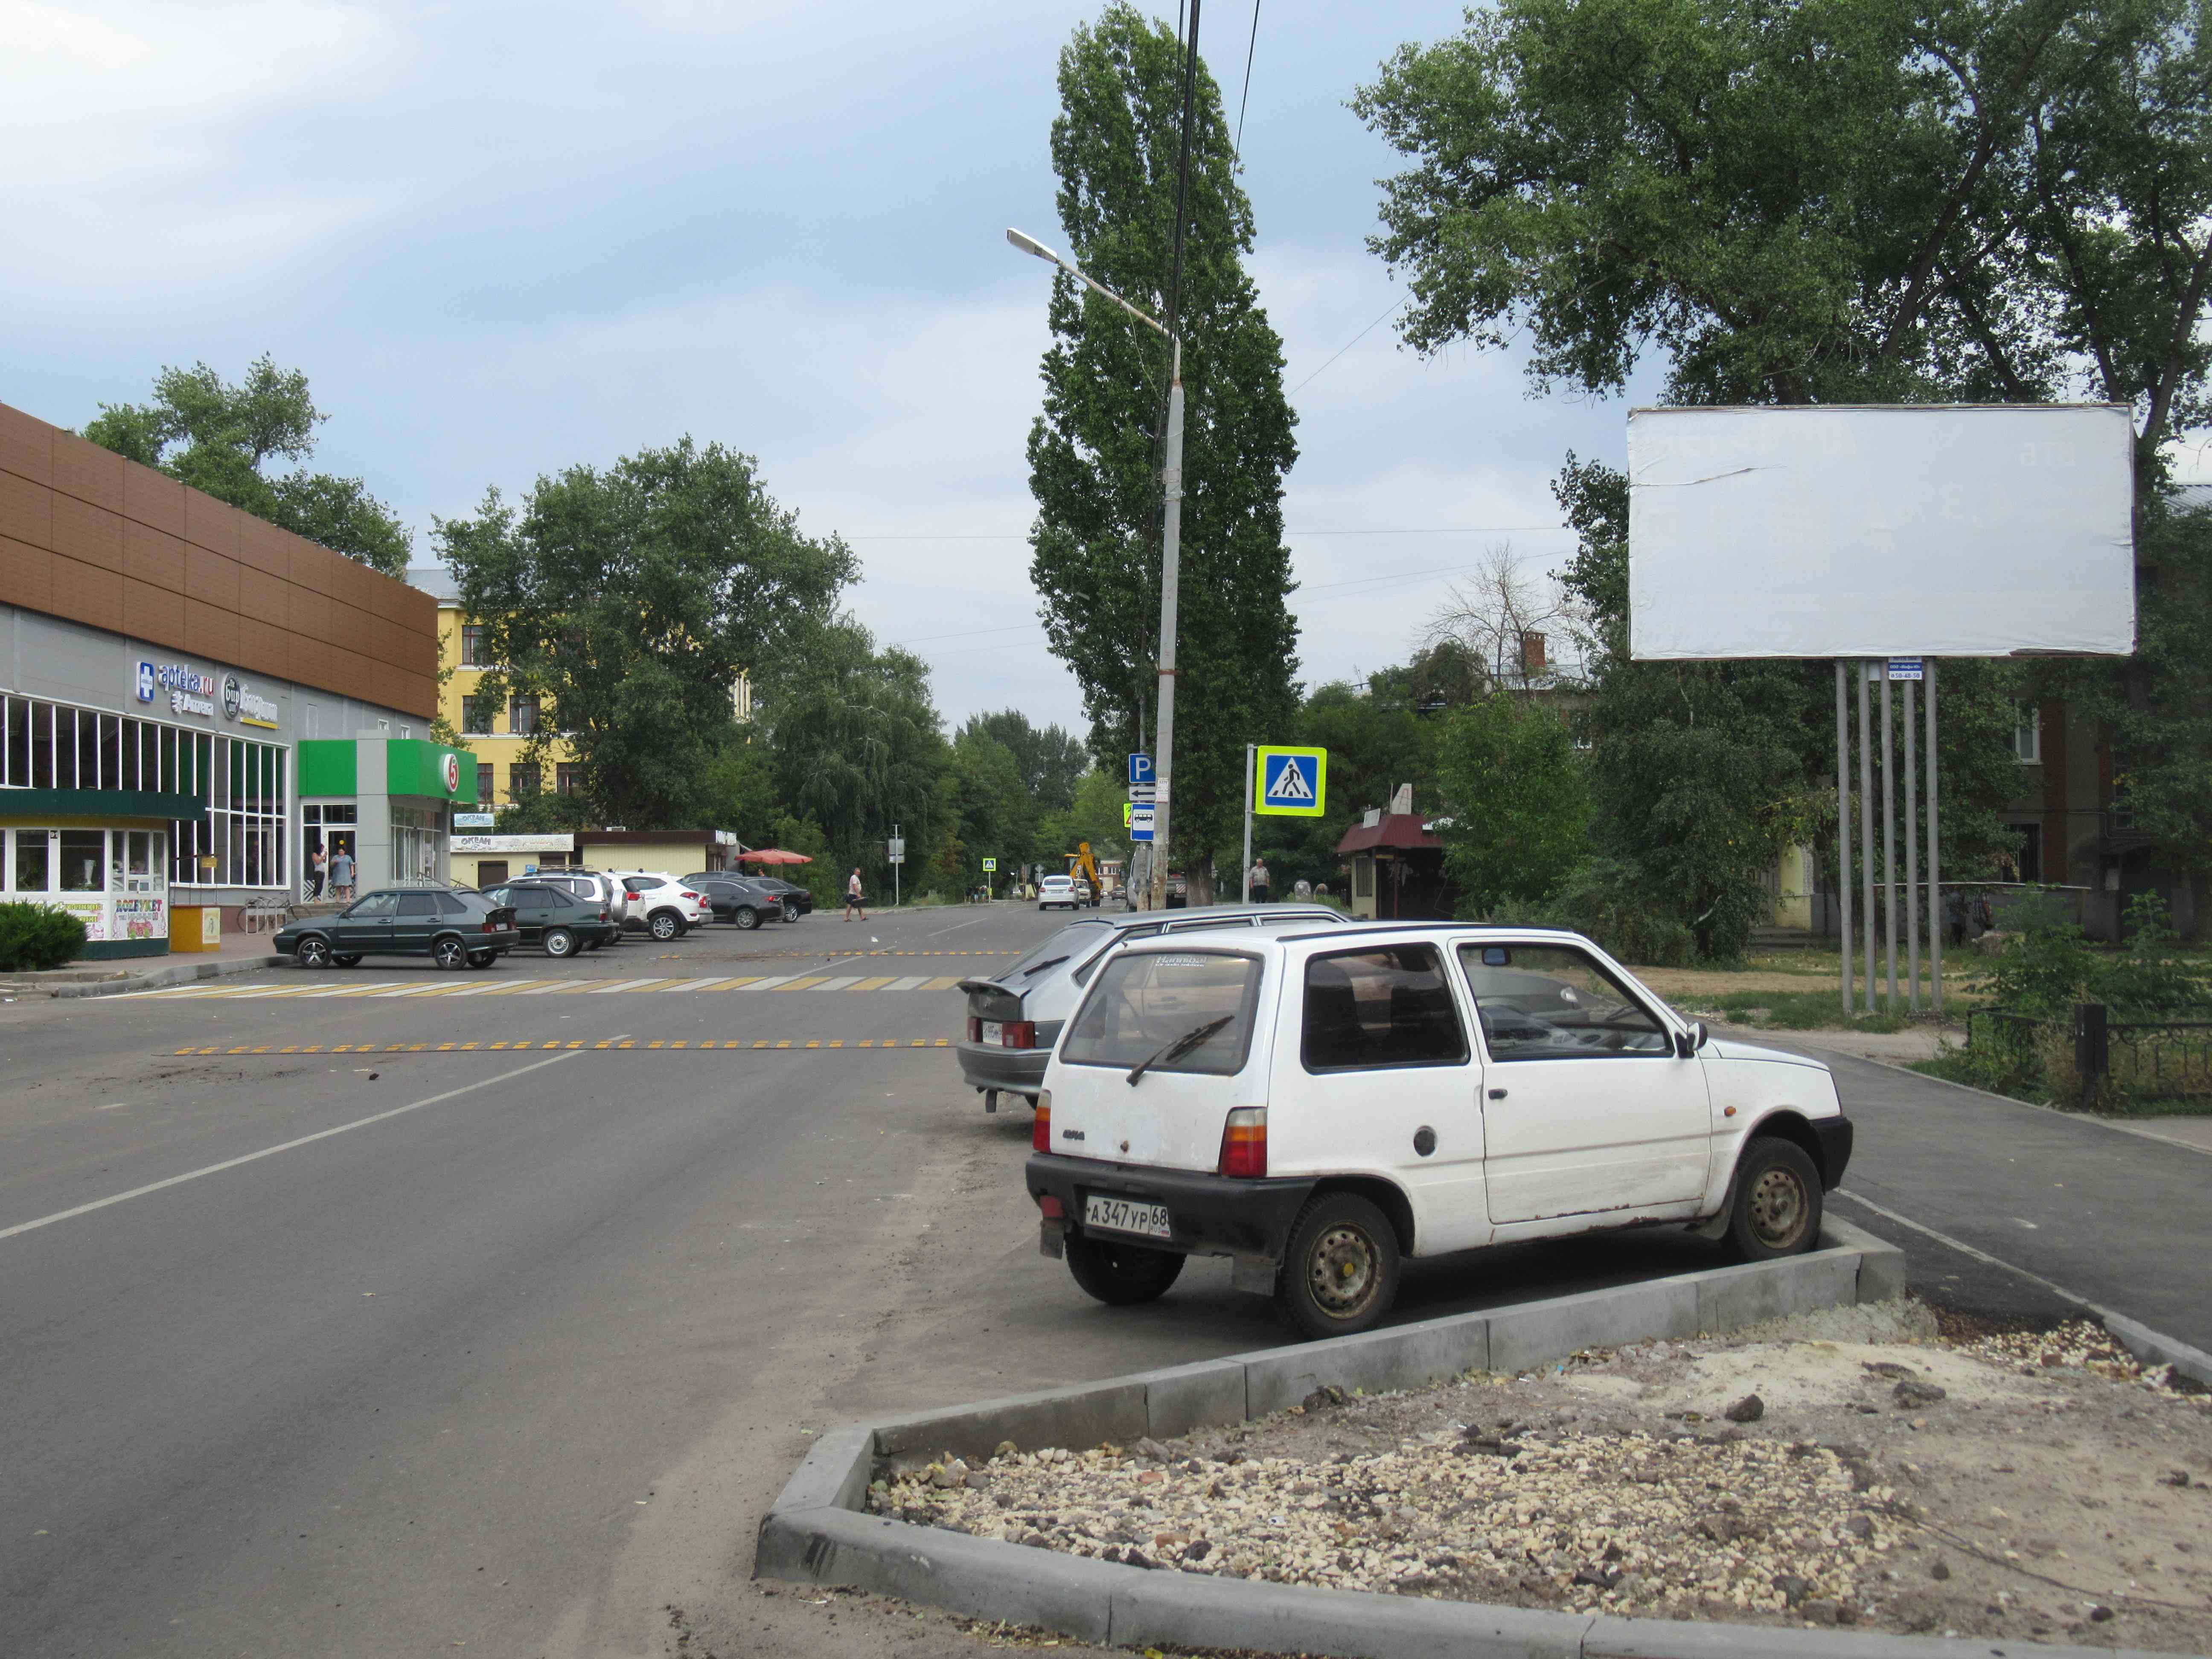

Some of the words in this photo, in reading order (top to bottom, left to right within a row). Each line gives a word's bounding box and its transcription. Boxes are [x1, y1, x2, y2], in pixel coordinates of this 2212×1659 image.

[158, 665, 214, 696] apteka.ru
[1136, 757, 1151, 780] P
[461, 837, 491, 845] ОКЕАН
[1152, 1207, 1167, 1226] 68
